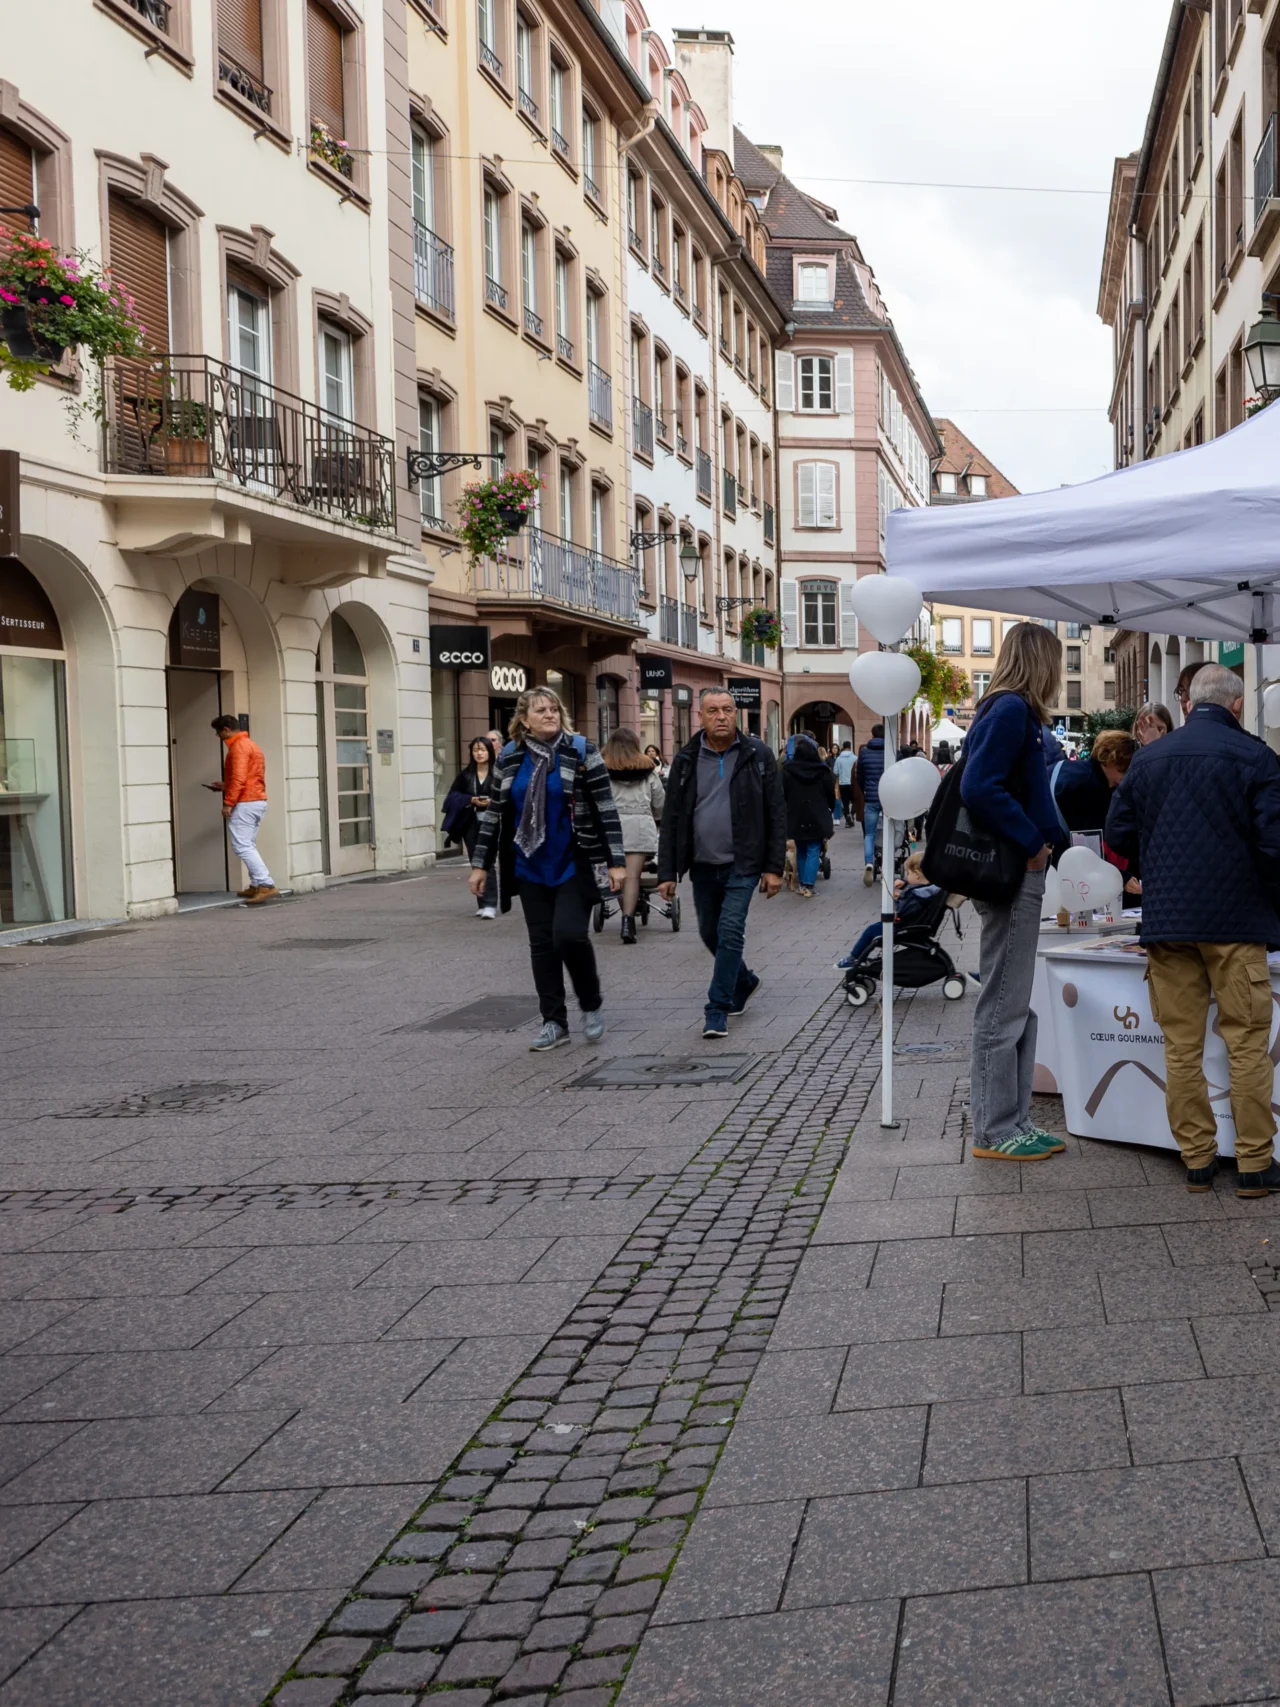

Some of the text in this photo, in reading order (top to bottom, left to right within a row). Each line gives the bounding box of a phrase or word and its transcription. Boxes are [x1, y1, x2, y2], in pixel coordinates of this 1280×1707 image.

[1, 615, 45, 630] SERTISSEUR
[440, 652, 483, 663] ecco
[491, 666, 526, 692] ecco
[944, 843, 996, 862] marant
